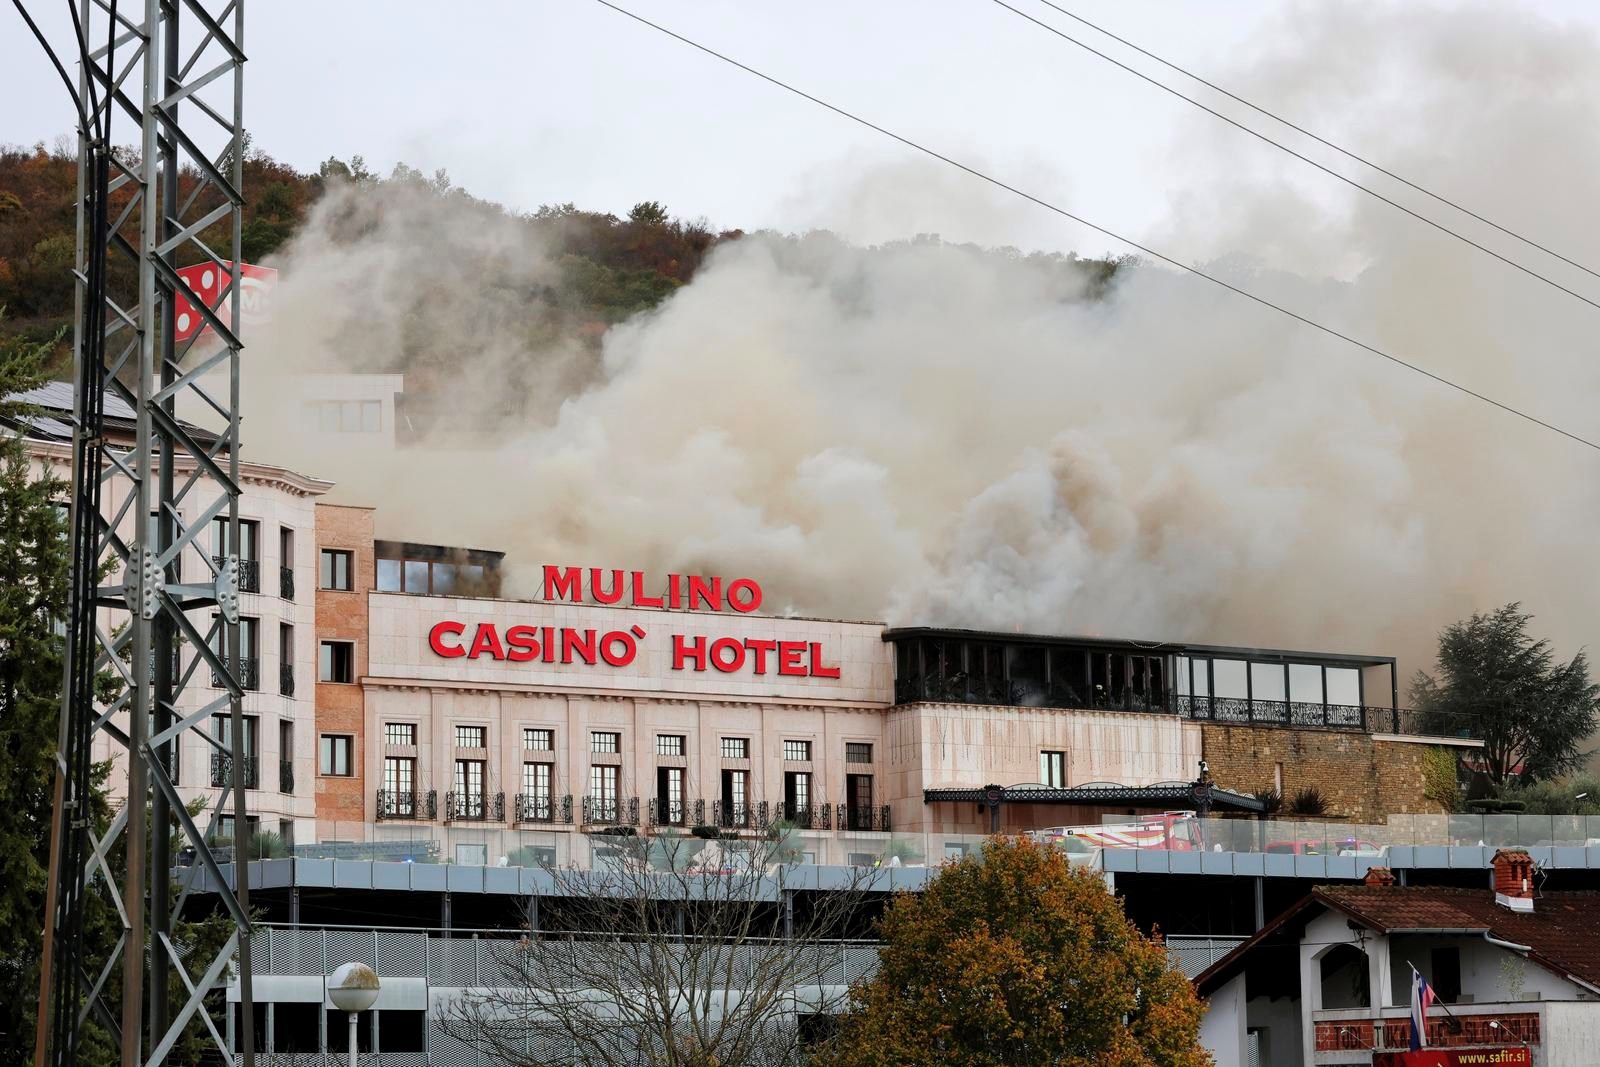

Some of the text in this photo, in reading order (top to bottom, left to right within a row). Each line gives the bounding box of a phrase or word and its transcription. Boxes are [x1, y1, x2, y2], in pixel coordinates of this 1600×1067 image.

[543, 565, 763, 613] MULINO
[672, 634, 840, 679] HOTEL
[1458, 1050, 1525, 1064] www.safir.si
